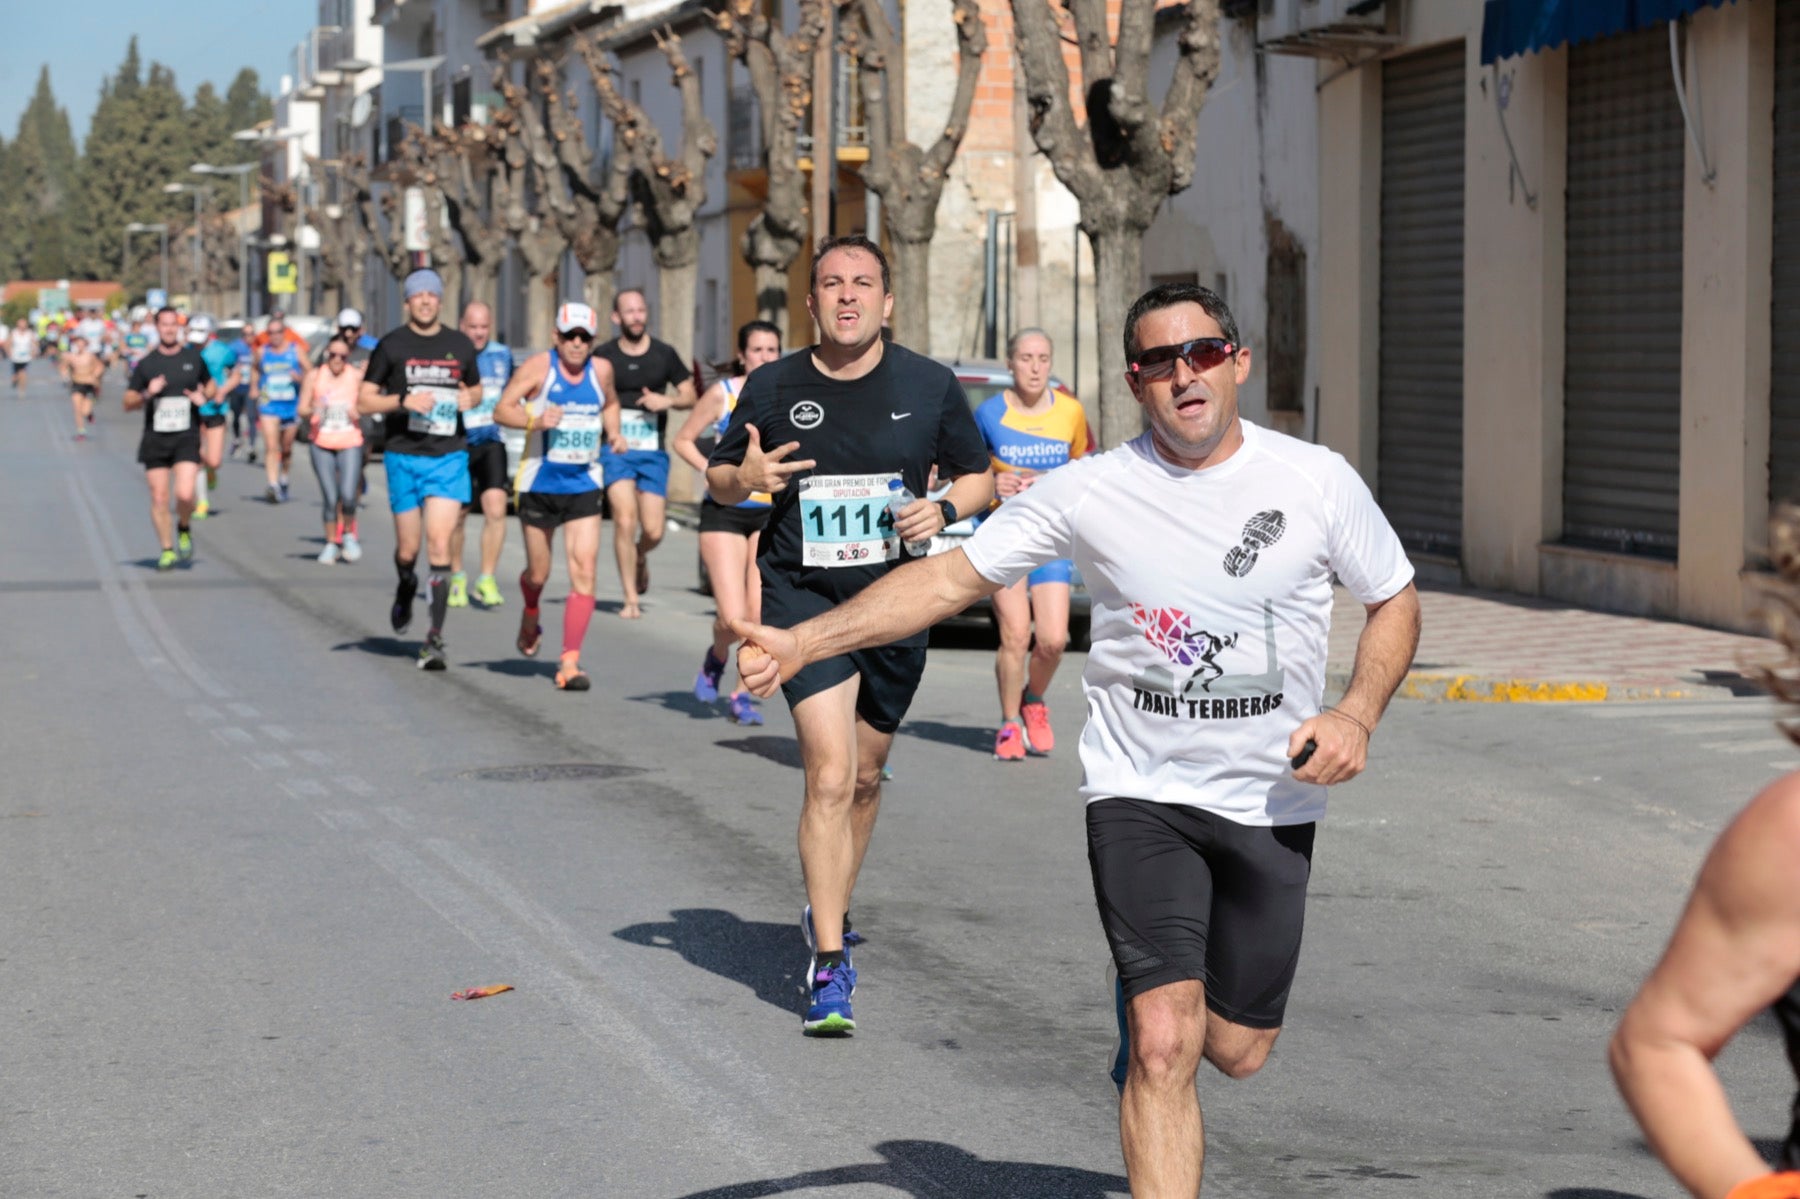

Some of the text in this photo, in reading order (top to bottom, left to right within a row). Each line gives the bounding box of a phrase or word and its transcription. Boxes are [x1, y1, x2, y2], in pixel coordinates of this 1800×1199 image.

[824, 479, 842, 488] GRAN
[843, 478, 866, 487] PREMIO
[867, 478, 875, 487] DE
[809, 504, 895, 536] 1114
[1134, 688, 1284, 719] TRAIL TERRERAS
